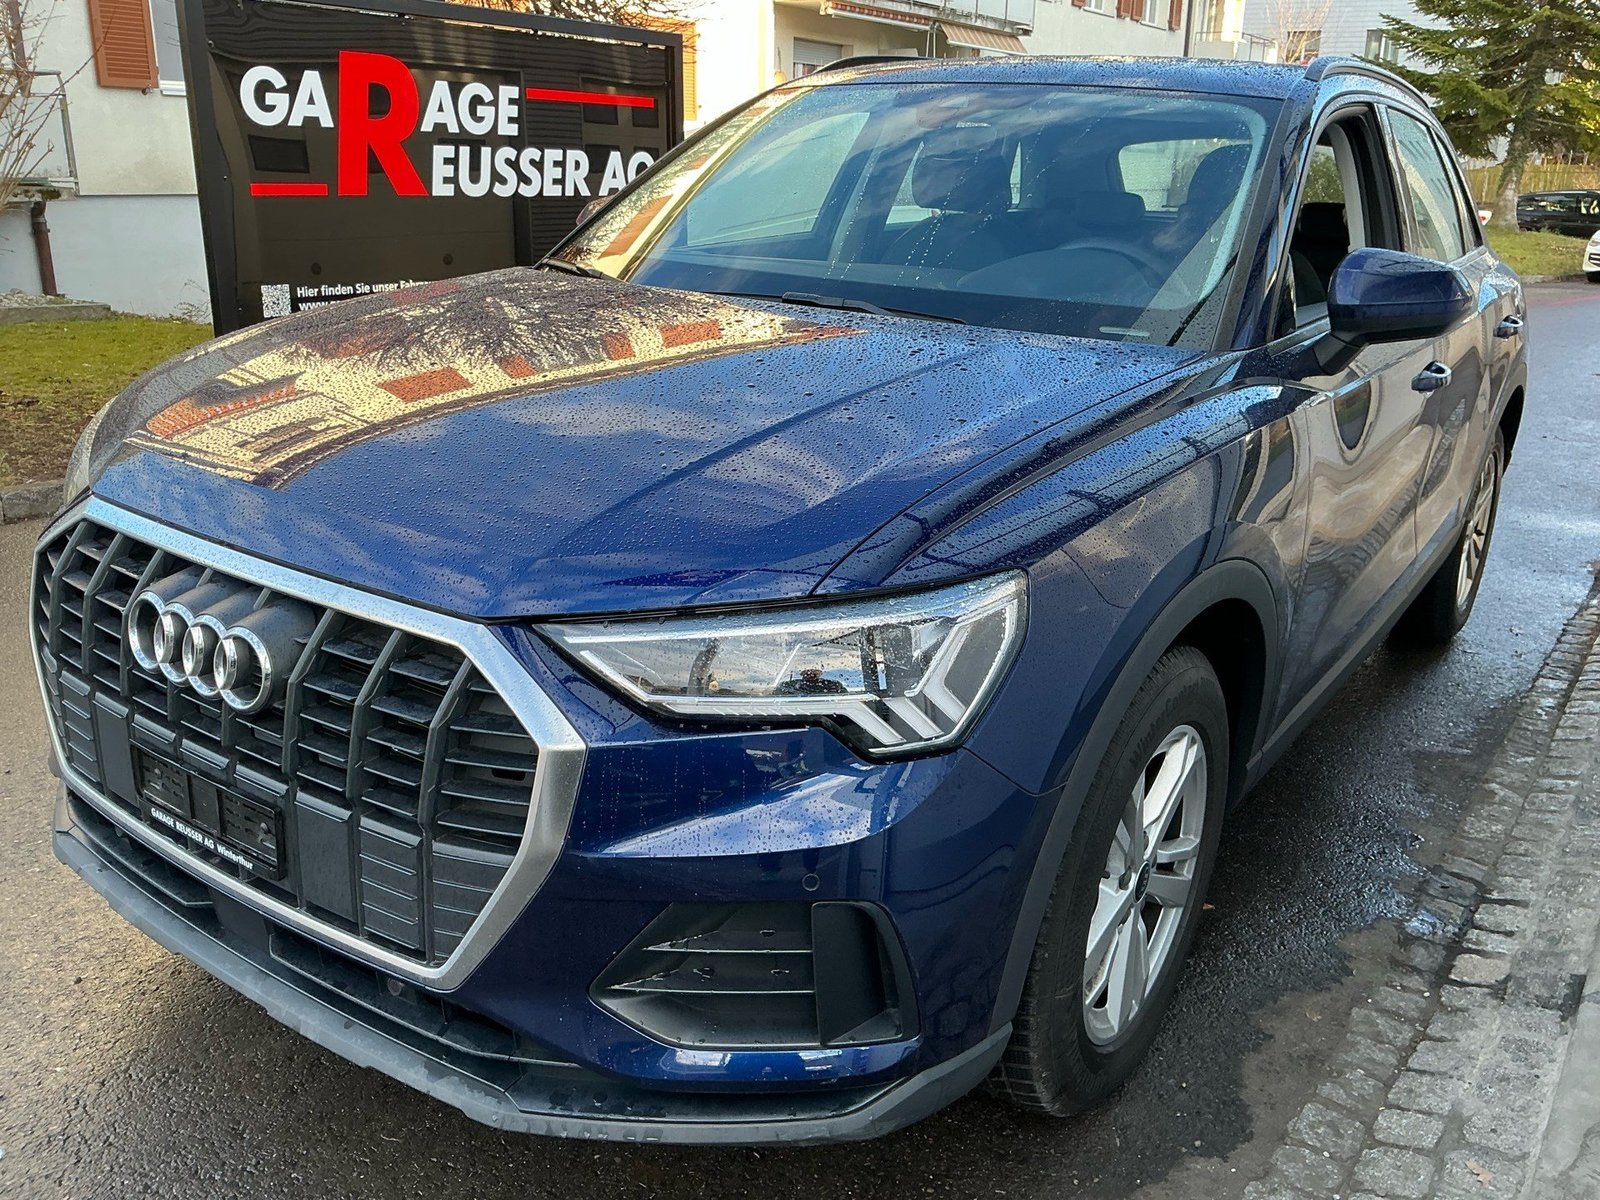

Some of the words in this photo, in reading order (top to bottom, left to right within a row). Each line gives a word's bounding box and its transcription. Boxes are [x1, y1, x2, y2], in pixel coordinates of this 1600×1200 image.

[240, 50, 520, 197] GARAGE
[297, 286, 319, 298] Hier
[321, 284, 354, 296] finden
[356, 282, 371, 294] Sie
[373, 282, 399, 293] unser
[151, 808, 174, 828] GARAGE
[175, 821, 203, 844] REUSSER
[204, 837, 215, 849] AG
[216, 843, 253, 870] Winterthur
